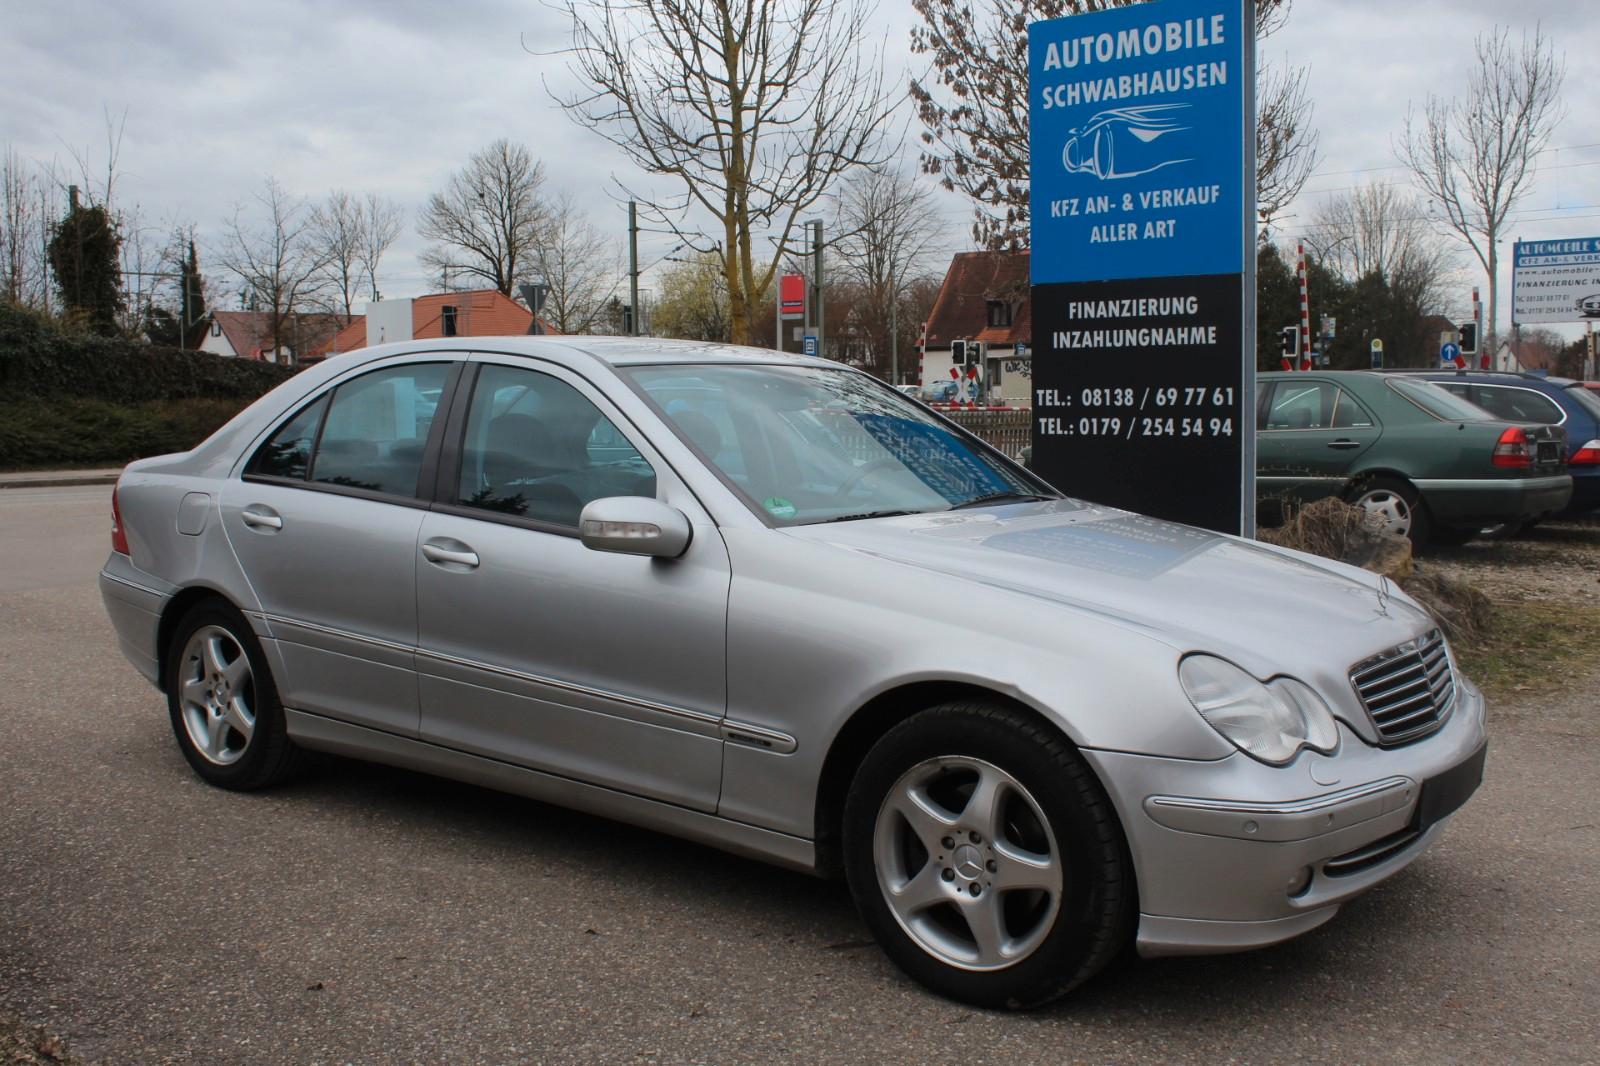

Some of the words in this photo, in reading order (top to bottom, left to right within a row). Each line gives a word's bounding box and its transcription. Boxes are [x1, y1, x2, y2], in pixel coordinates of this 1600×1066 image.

[1043, 14, 1226, 71] AUTOMOBILE
[1042, 61, 1227, 109] SCHWABHAUSEN
[1051, 198, 1079, 217] KFZ
[1085, 196, 1116, 214] AN-
[1122, 194, 1134, 211] &
[1139, 185, 1220, 209] VERKAUF
[1090, 223, 1137, 243] ALLER
[1143, 220, 1176, 239] ART
[1069, 296, 1198, 319] FINANZIERUNG
[1053, 326, 1217, 349] INZAHLUNGNAHME
[1036, 389, 1071, 406] TEL.:
[1082, 388, 1134, 407] 08138
[1139, 387, 1150, 410] /
[1156, 387, 1178, 406] 69
[1185, 387, 1207, 406] 77
[1212, 387, 1233, 406] 61
[1039, 417, 1074, 435] TEL.:
[1079, 417, 1121, 436] 0179
[1126, 417, 1136, 440] /
[1142, 417, 1175, 436] 254
[1181, 418, 1203, 436] 54
[1209, 418, 1233, 436] 94
